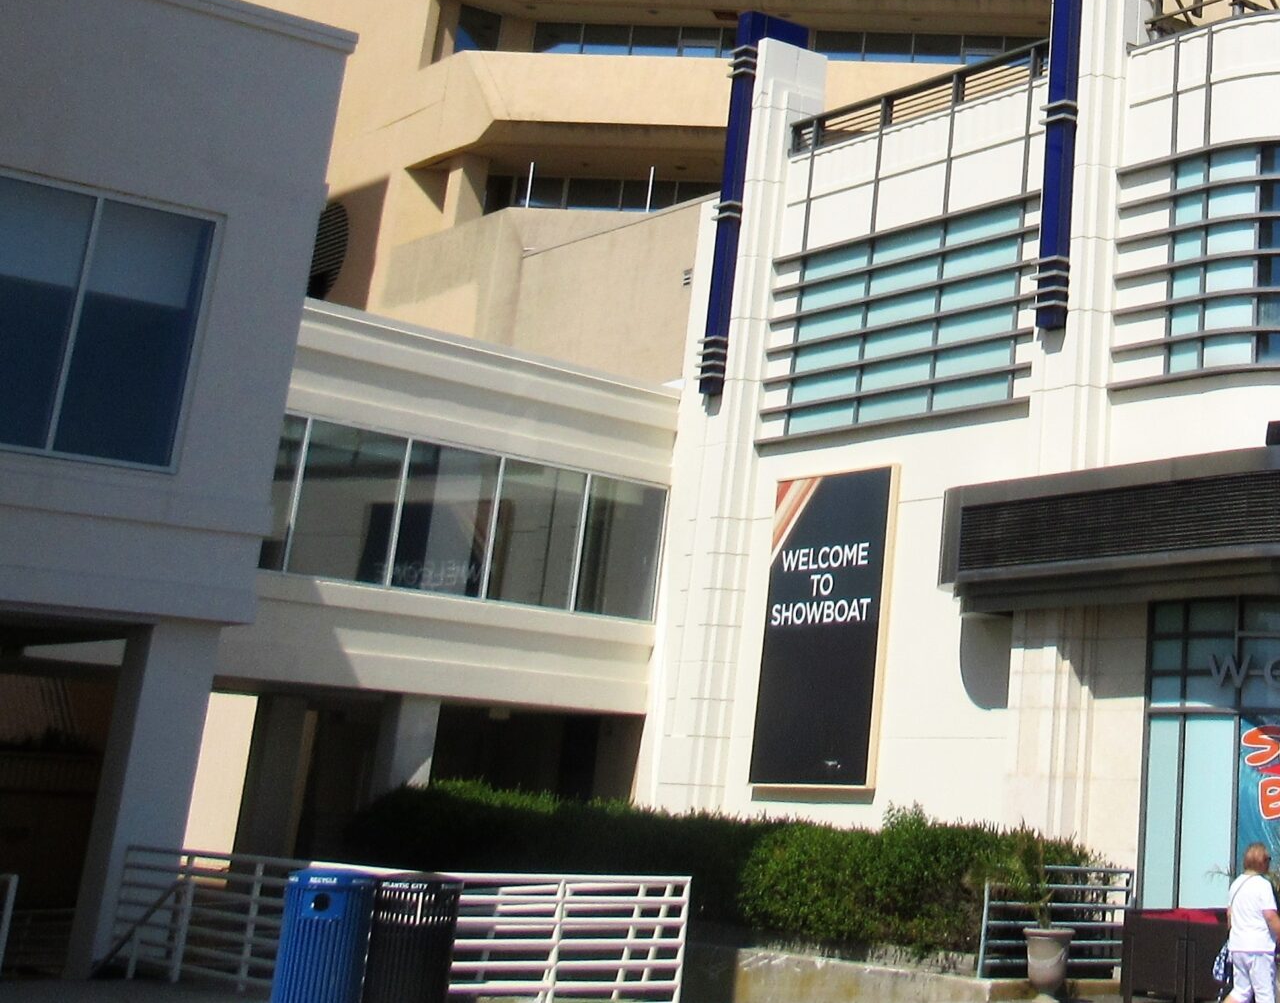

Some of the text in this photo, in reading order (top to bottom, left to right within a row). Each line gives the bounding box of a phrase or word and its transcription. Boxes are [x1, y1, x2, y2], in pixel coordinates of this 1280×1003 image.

[782, 542, 870, 572] WELCOME
[810, 573, 833, 596] TO
[771, 598, 871, 626] SHOWBOAT
